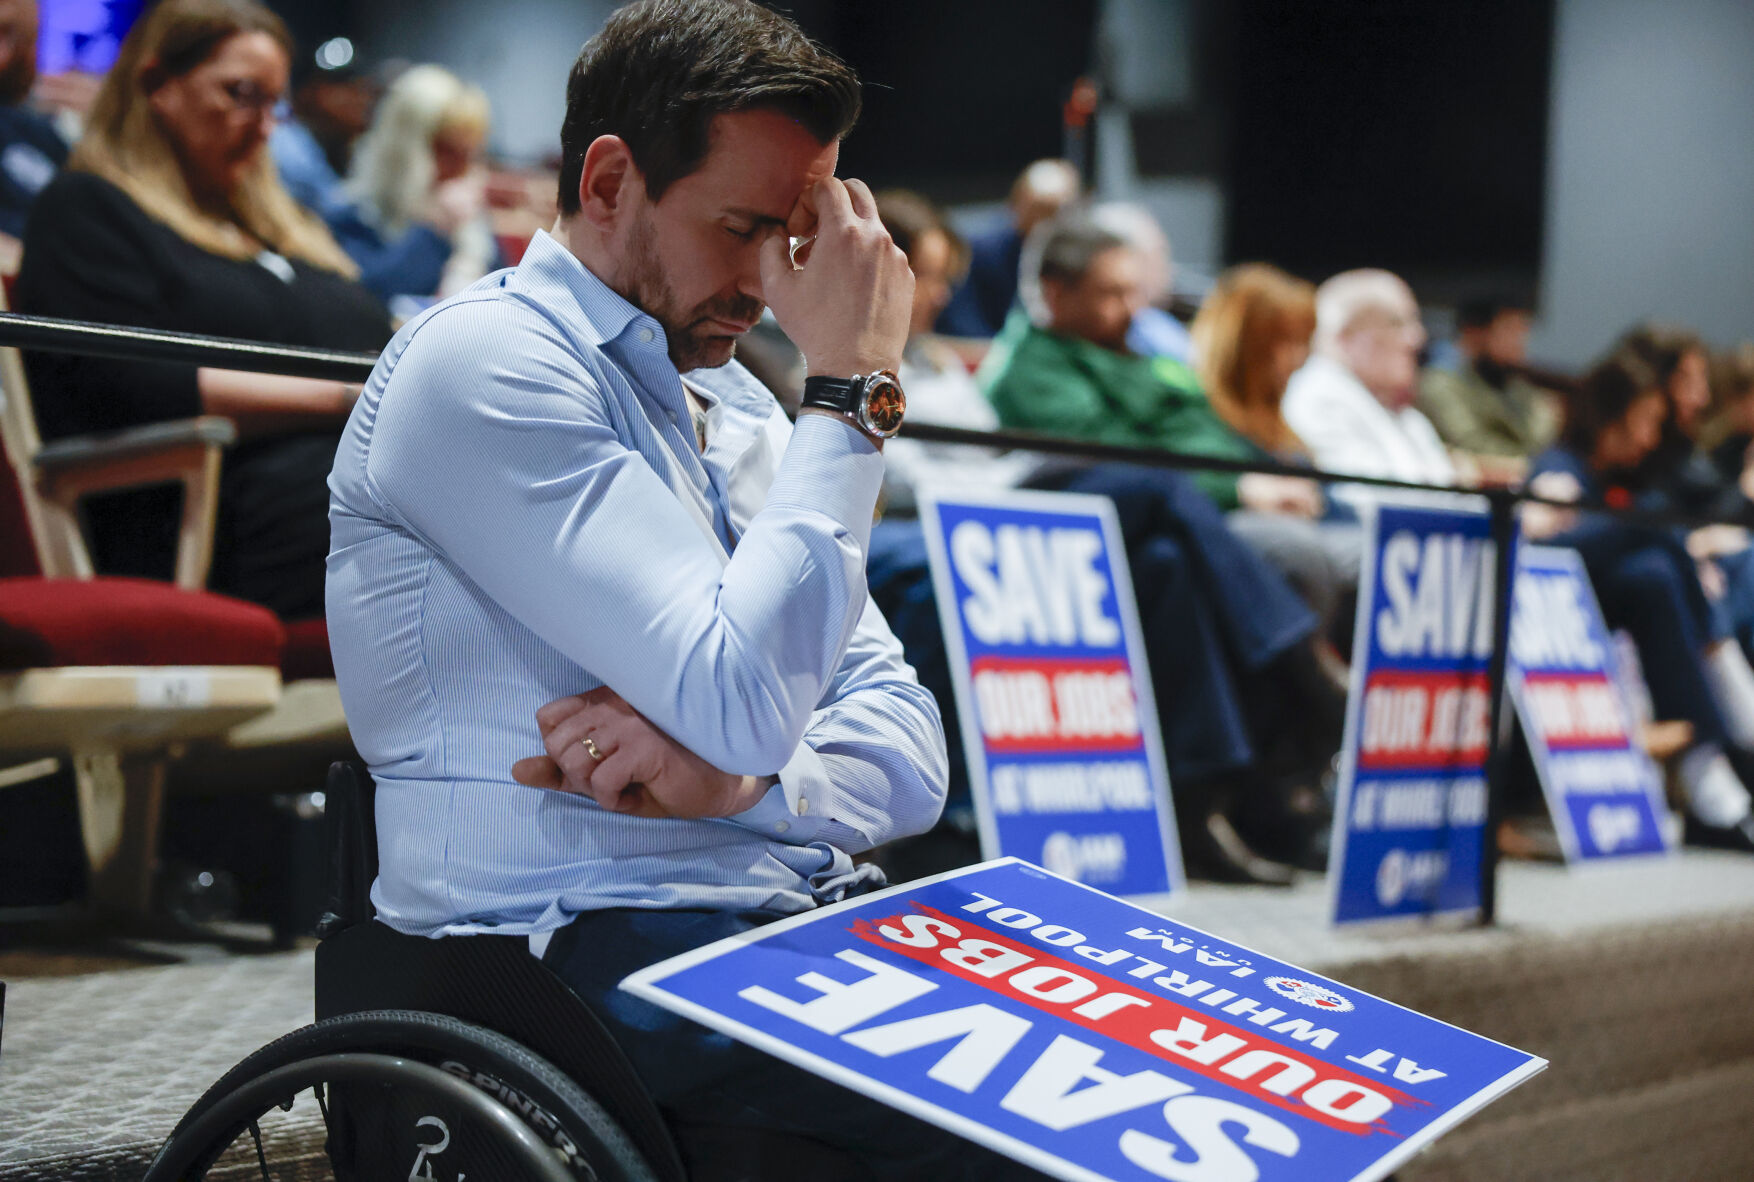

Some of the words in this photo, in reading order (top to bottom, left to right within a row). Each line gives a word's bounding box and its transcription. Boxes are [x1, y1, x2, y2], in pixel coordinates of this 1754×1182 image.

[950, 519, 1121, 648] SAVE
[974, 668, 1055, 741] OUR
[878, 914, 1153, 1021] JOBS
[960, 891, 1340, 1051] WHIRLPOOL
[1125, 927, 1257, 978] IAM
[1157, 928, 1252, 966] UNION
[737, 948, 1300, 1182] SAVE
[1149, 1017, 1393, 1124] OUR
[1345, 1049, 1448, 1085] AT
